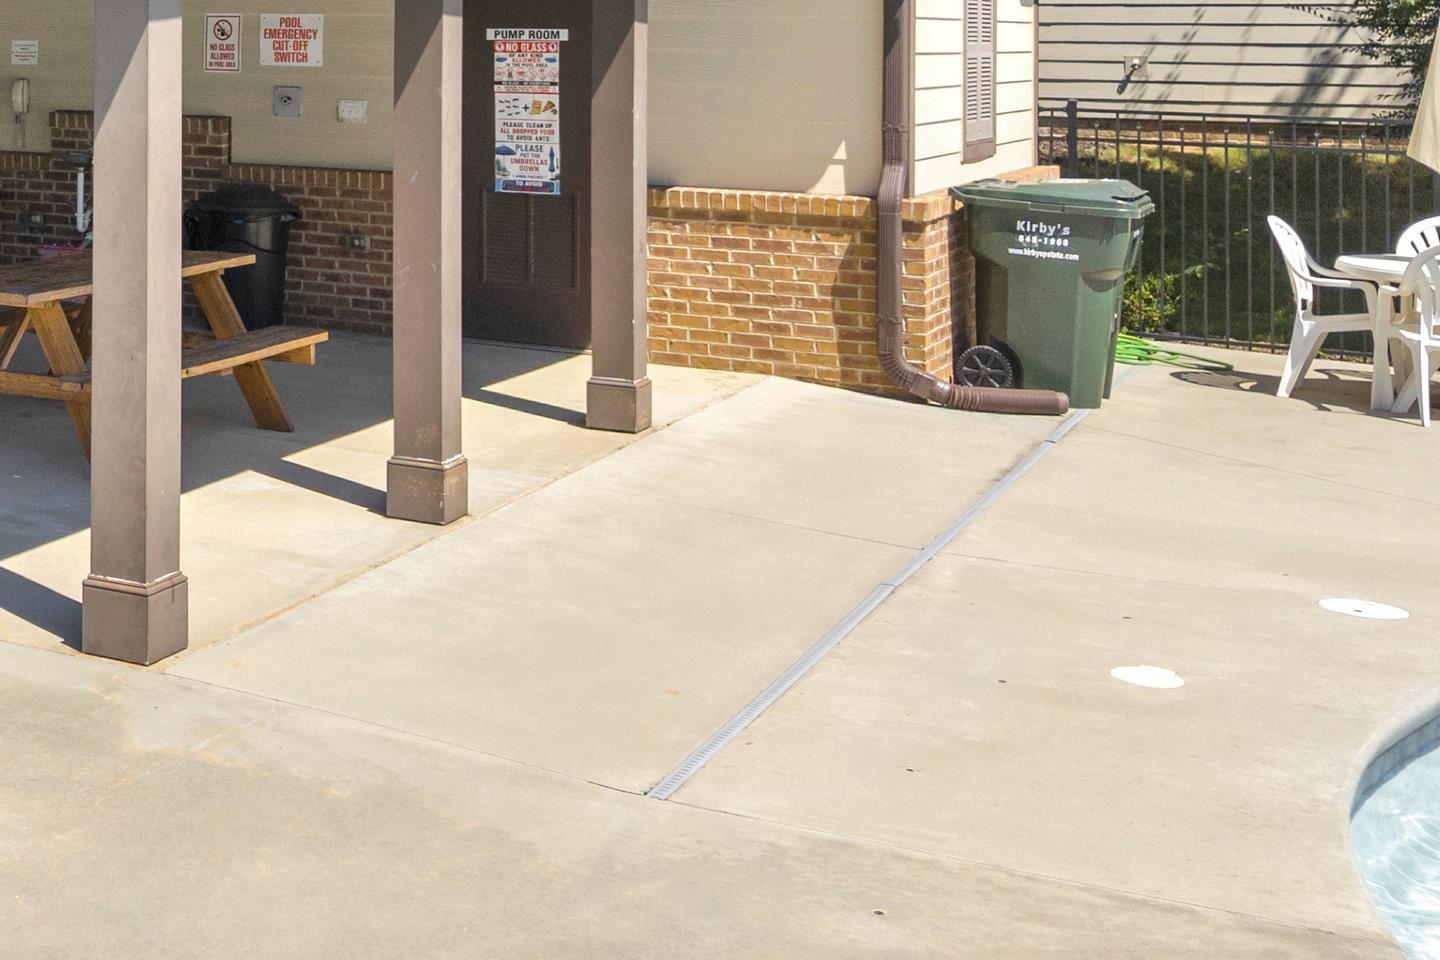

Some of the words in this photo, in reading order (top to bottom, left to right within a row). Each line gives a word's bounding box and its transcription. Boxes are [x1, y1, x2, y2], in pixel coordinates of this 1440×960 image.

[279, 17, 303, 28] POOL
[263, 28, 319, 40] EMERGENCY
[494, 30, 526, 39] PUMP
[528, 30, 561, 40] ROOM
[209, 43, 218, 51] NO
[218, 43, 236, 52] GLASS
[272, 40, 310, 51] CUT-OFF
[505, 42, 518, 52] NO
[520, 42, 548, 53] GLASS
[210, 52, 236, 60] ALLOWED
[273, 51, 309, 63] SWITCH
[515, 144, 544, 152] PLEASE
[511, 158, 549, 166] UMBRELLAS
[1016, 220, 1071, 237] Kirby's
